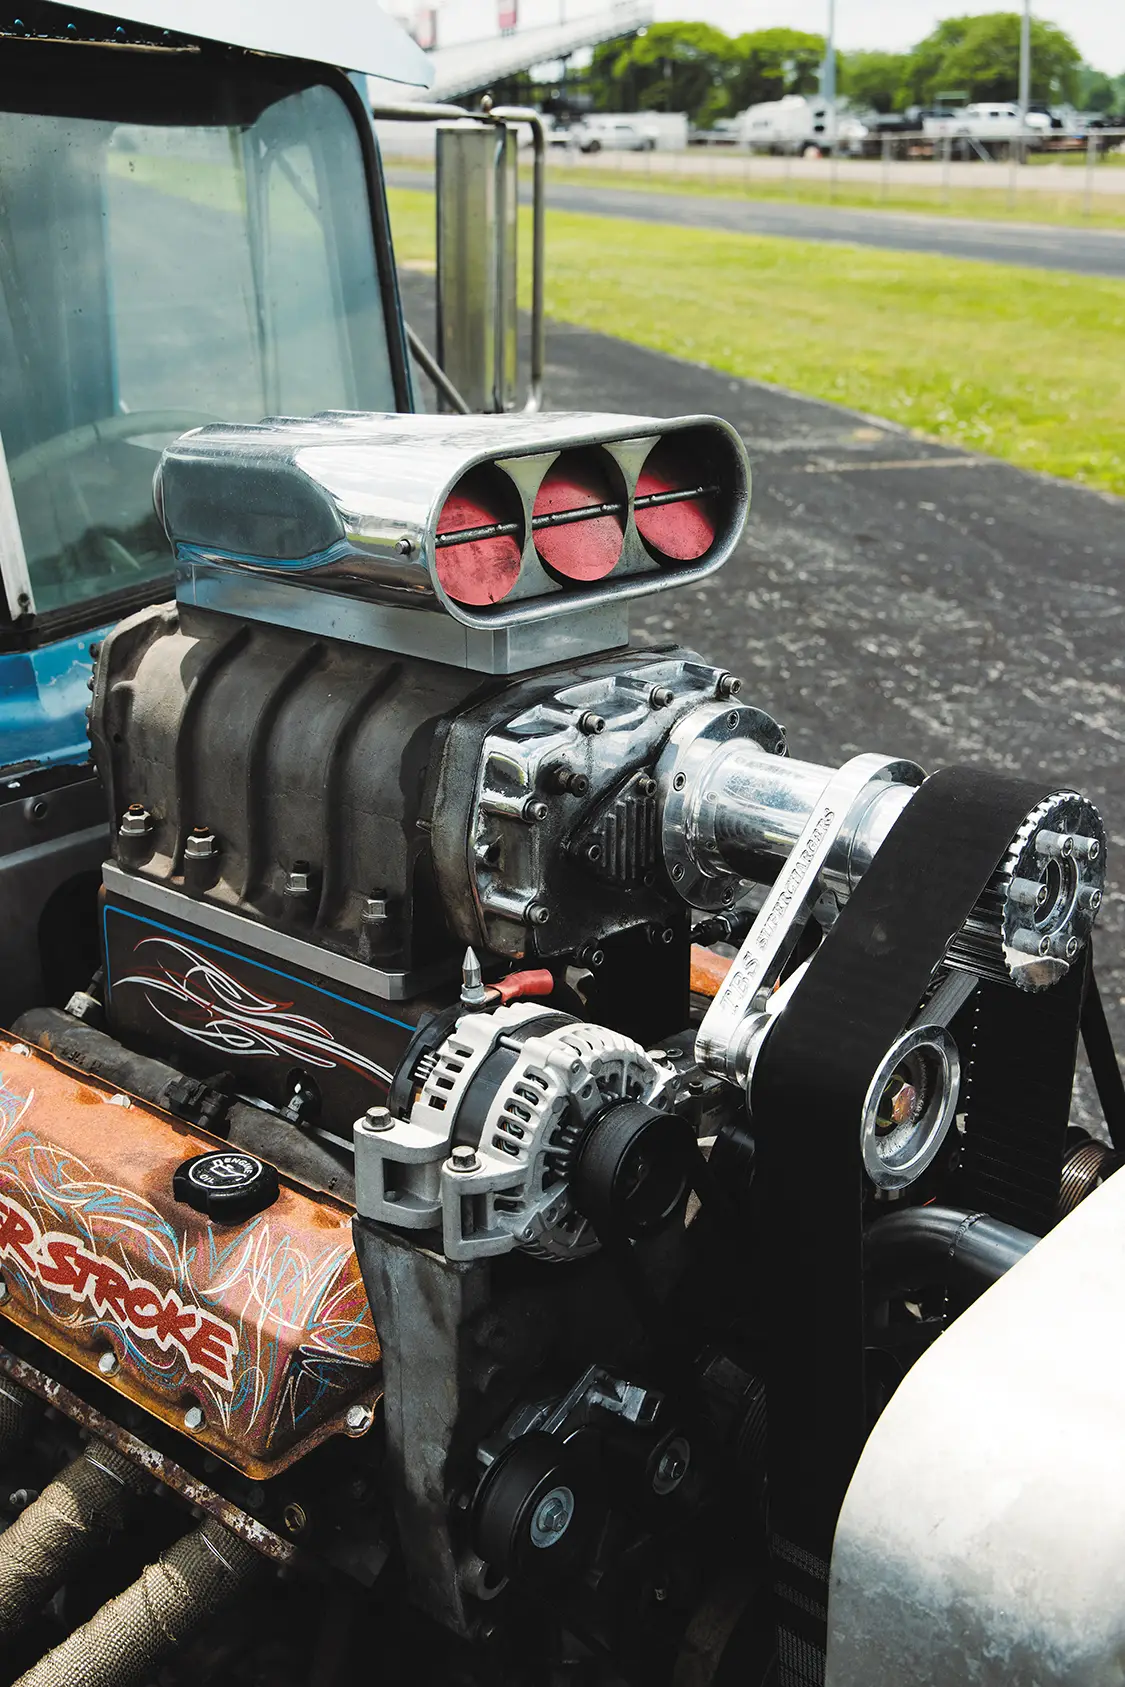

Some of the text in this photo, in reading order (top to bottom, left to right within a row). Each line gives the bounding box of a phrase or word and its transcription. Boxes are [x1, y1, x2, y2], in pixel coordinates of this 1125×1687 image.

[719, 807, 835, 1015] TBS SUPERCHARGERS
[199, 1174, 214, 1184] OIL
[223, 1157, 253, 1174] ENGINE
[0, 1195, 238, 1392] RSTROKE
